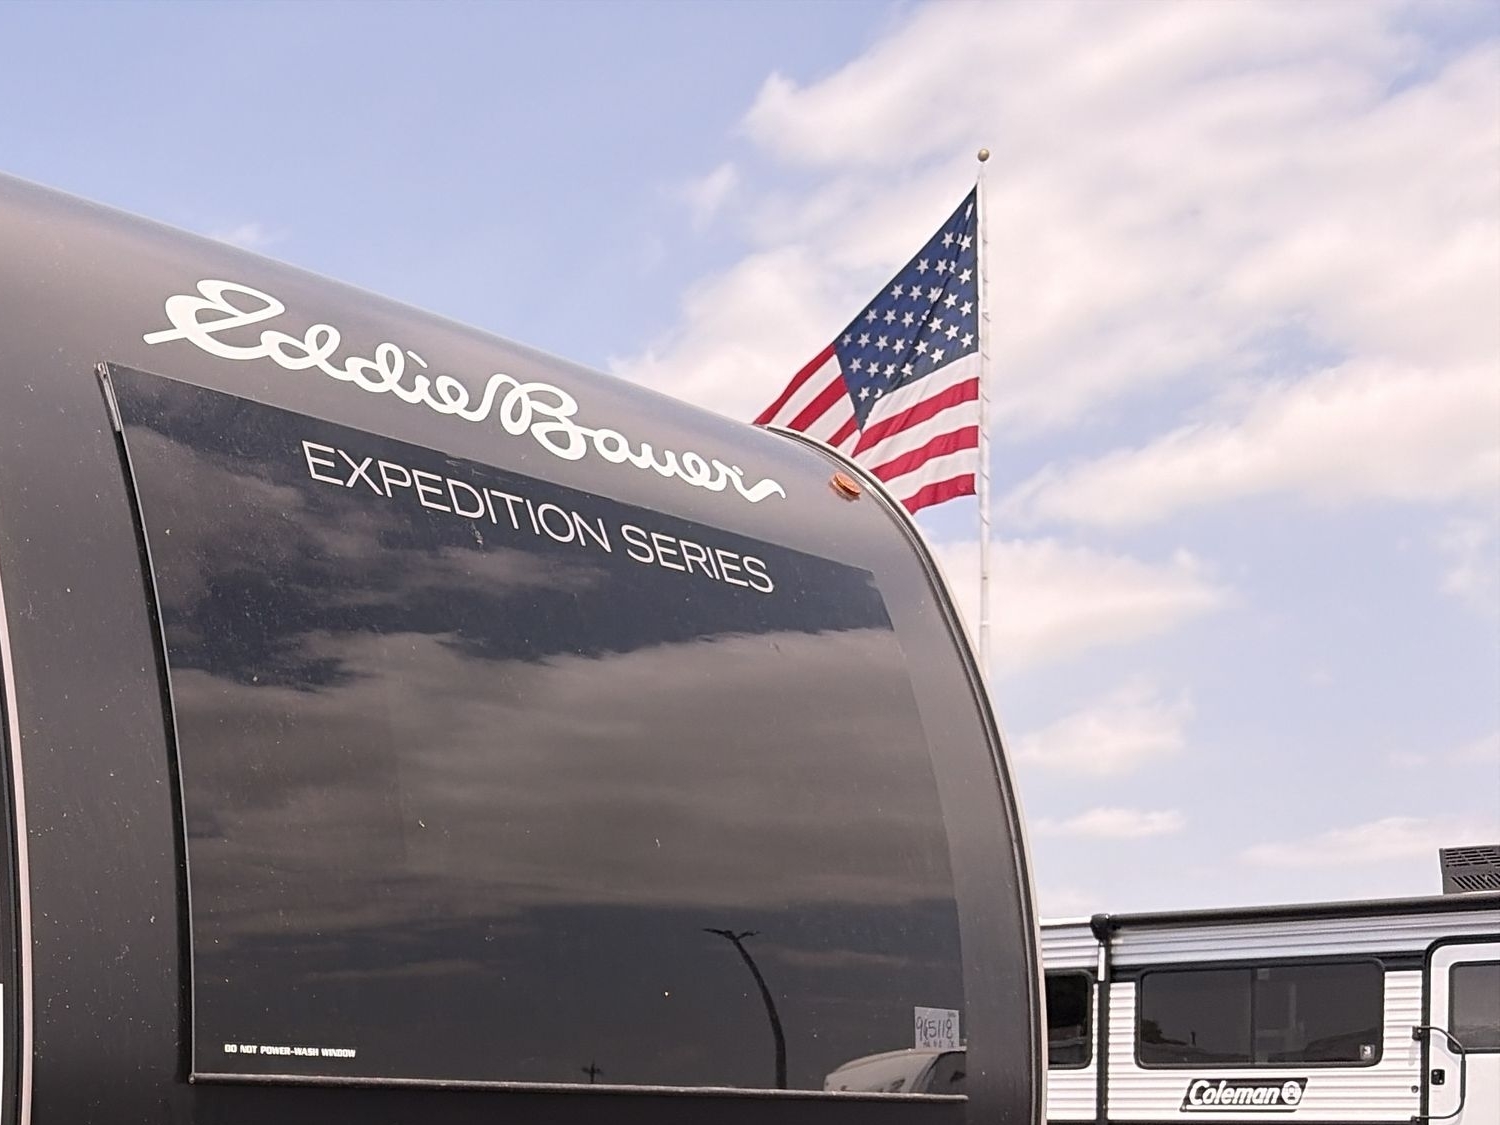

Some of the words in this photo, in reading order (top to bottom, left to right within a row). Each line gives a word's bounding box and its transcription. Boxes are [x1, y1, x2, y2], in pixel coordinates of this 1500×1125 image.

[144, 279, 484, 422] Eddie
[302, 440, 611, 553] EXPEDITION
[620, 524, 775, 594] SERIES
[224, 1044, 237, 1053] DO
[240, 1045, 257, 1054] NOT
[260, 1046, 319, 1056] POWER-WASH
[321, 1048, 356, 1058] WINDOW
[1189, 1080, 1280, 1105] Coleman
